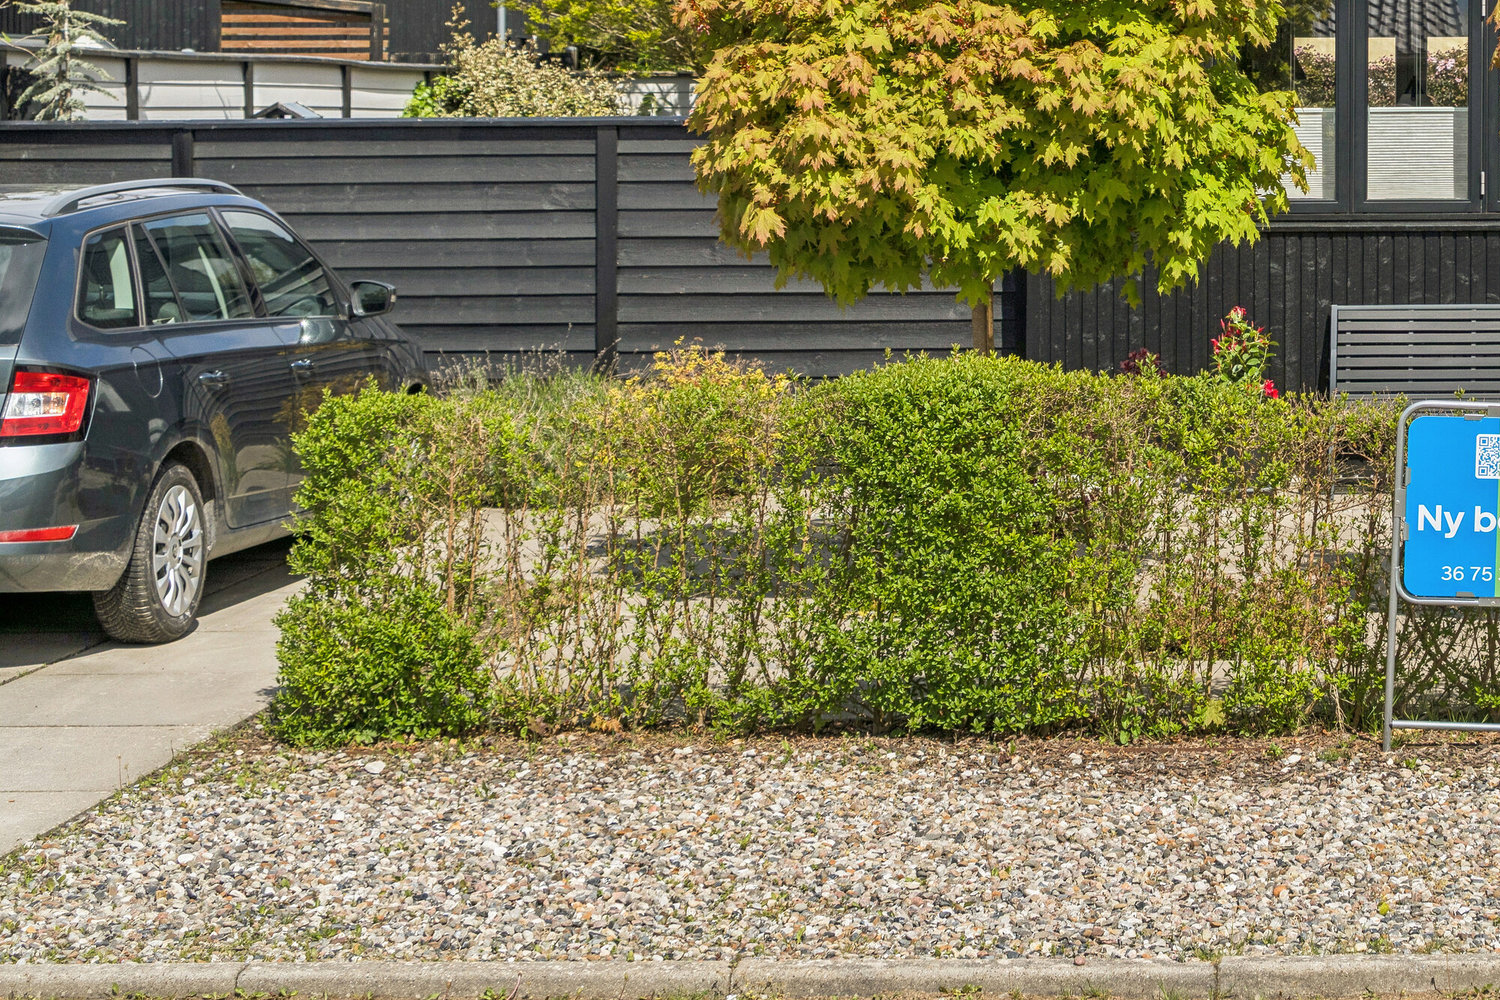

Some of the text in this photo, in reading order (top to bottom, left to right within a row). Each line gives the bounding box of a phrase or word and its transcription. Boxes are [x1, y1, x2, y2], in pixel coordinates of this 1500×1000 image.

[1417, 504, 1465, 539] Ny
[1441, 566, 1465, 581] 36
[1470, 566, 1493, 582] 75
